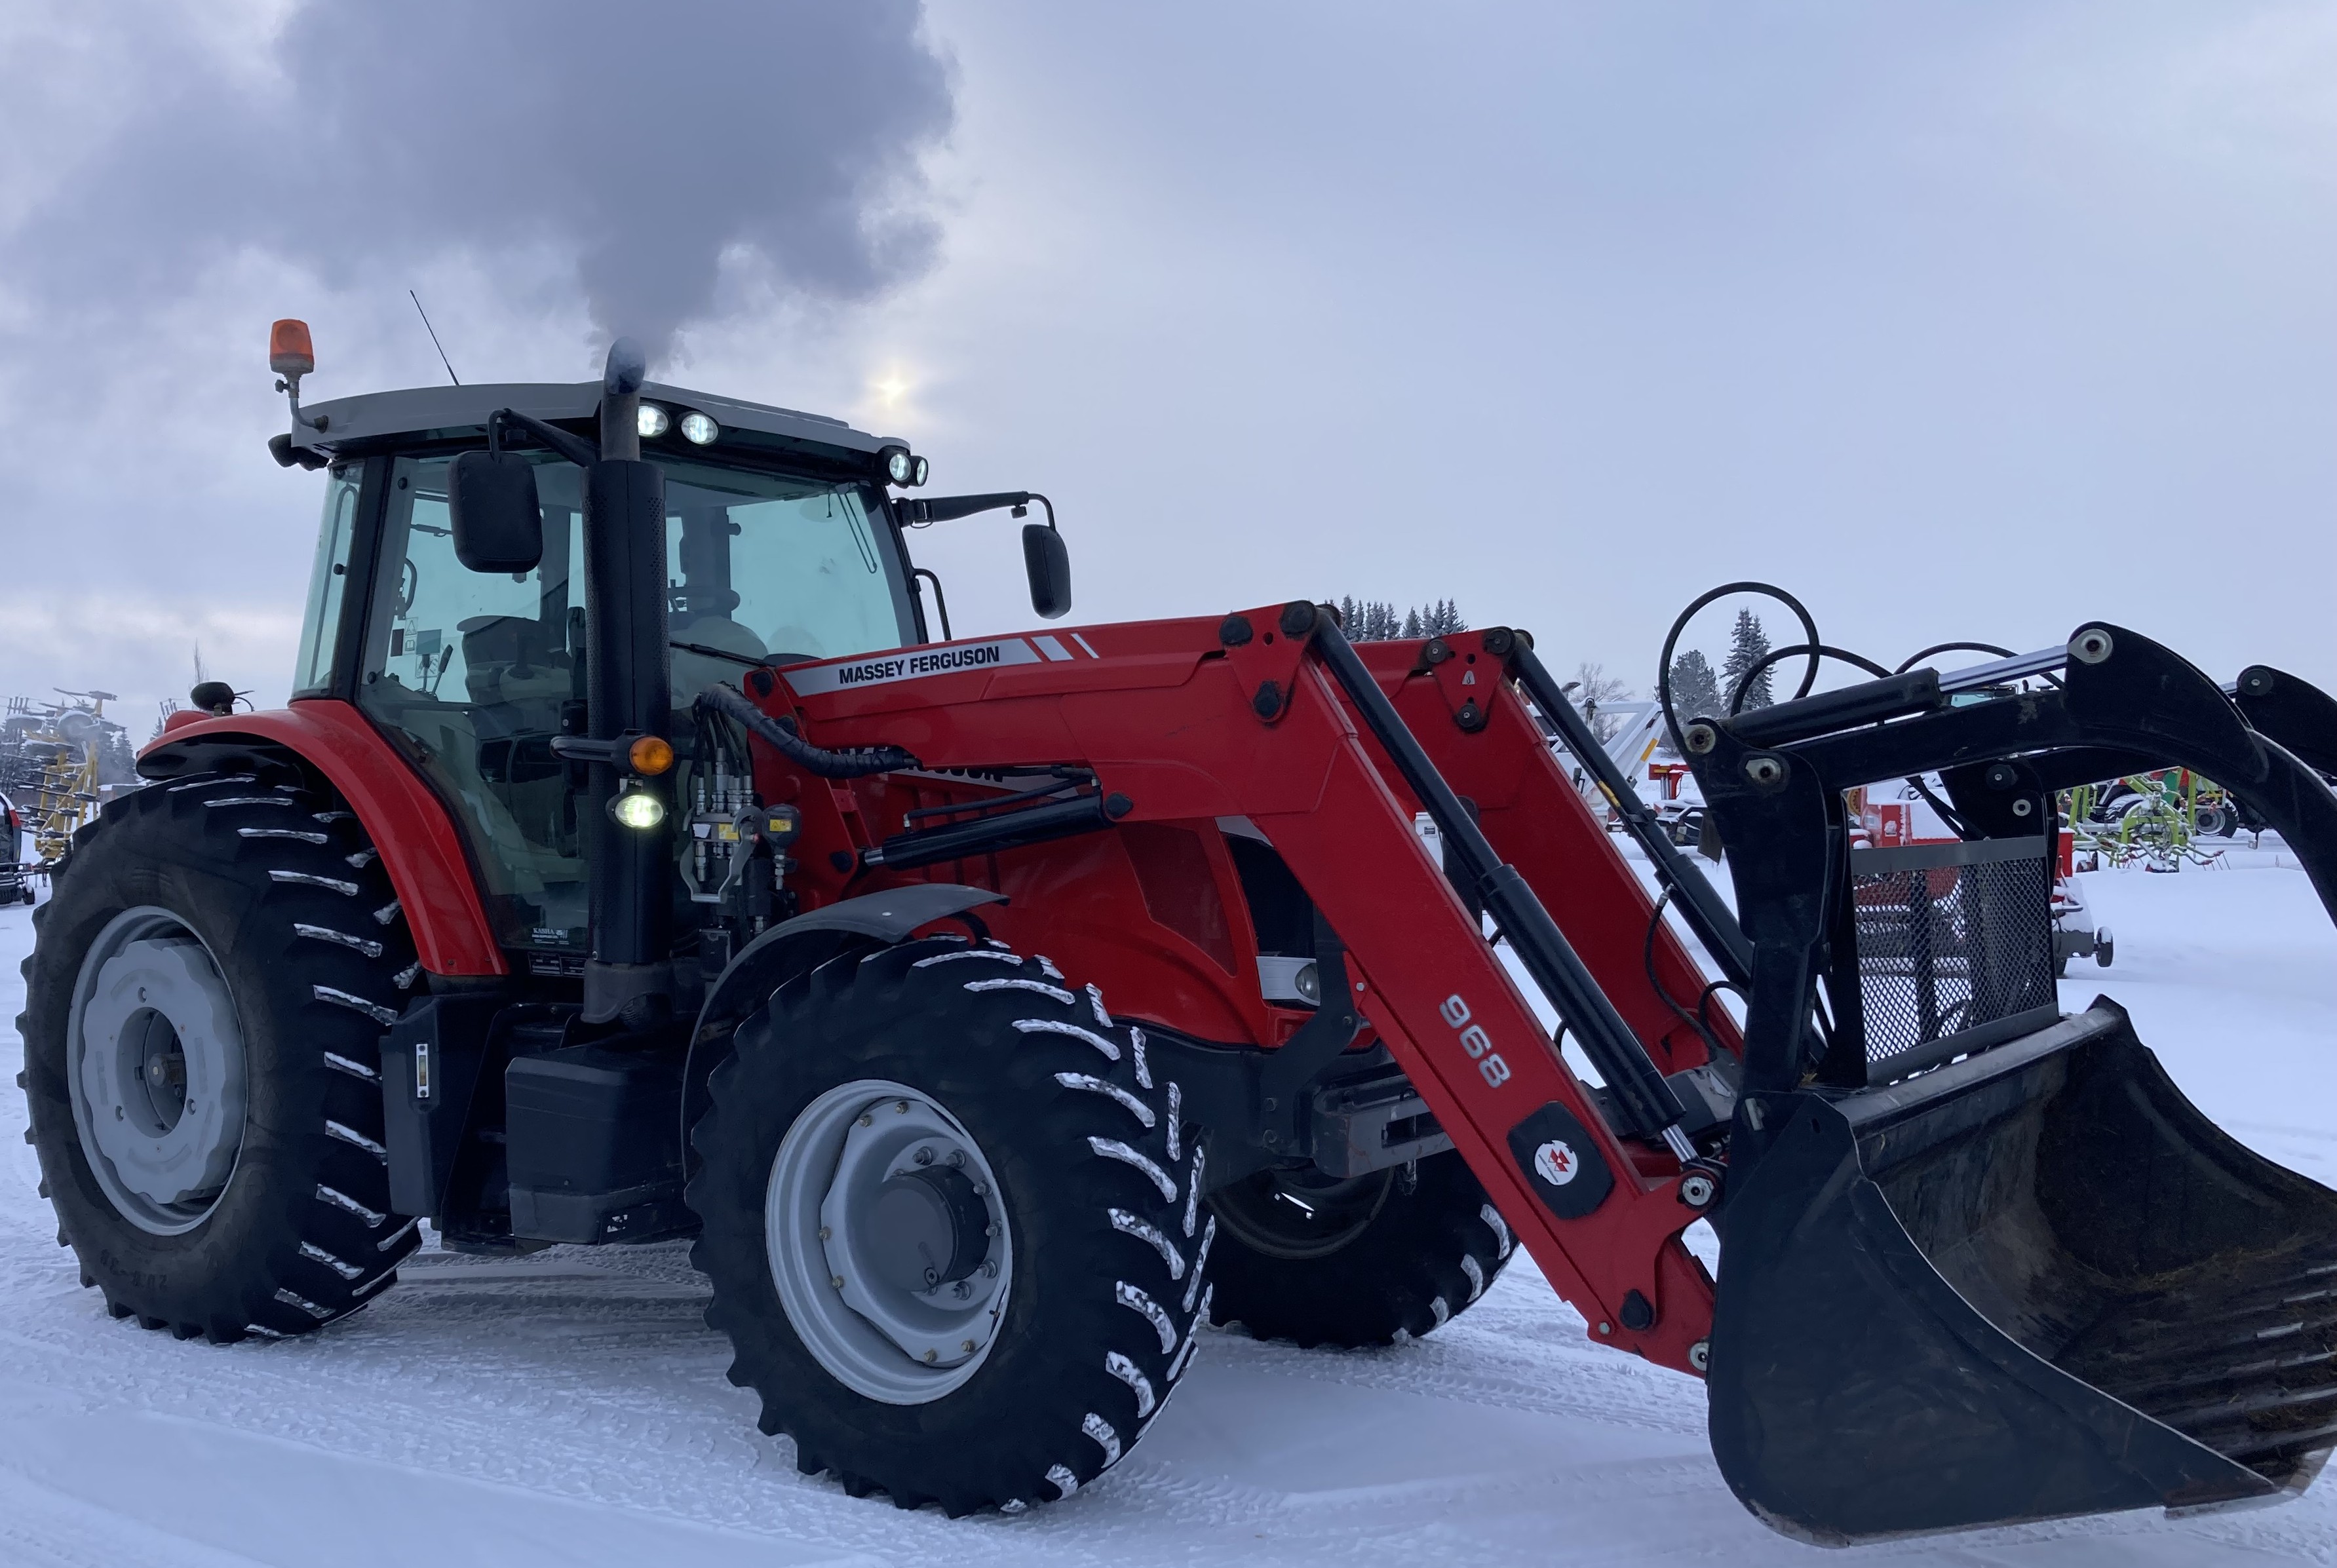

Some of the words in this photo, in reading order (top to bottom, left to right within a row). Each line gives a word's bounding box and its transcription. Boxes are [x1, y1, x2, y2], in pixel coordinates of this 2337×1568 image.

[839, 659, 905, 684] MASSEY
[910, 645, 1000, 674] FERGUSON
[1439, 994, 1511, 1088] 968
